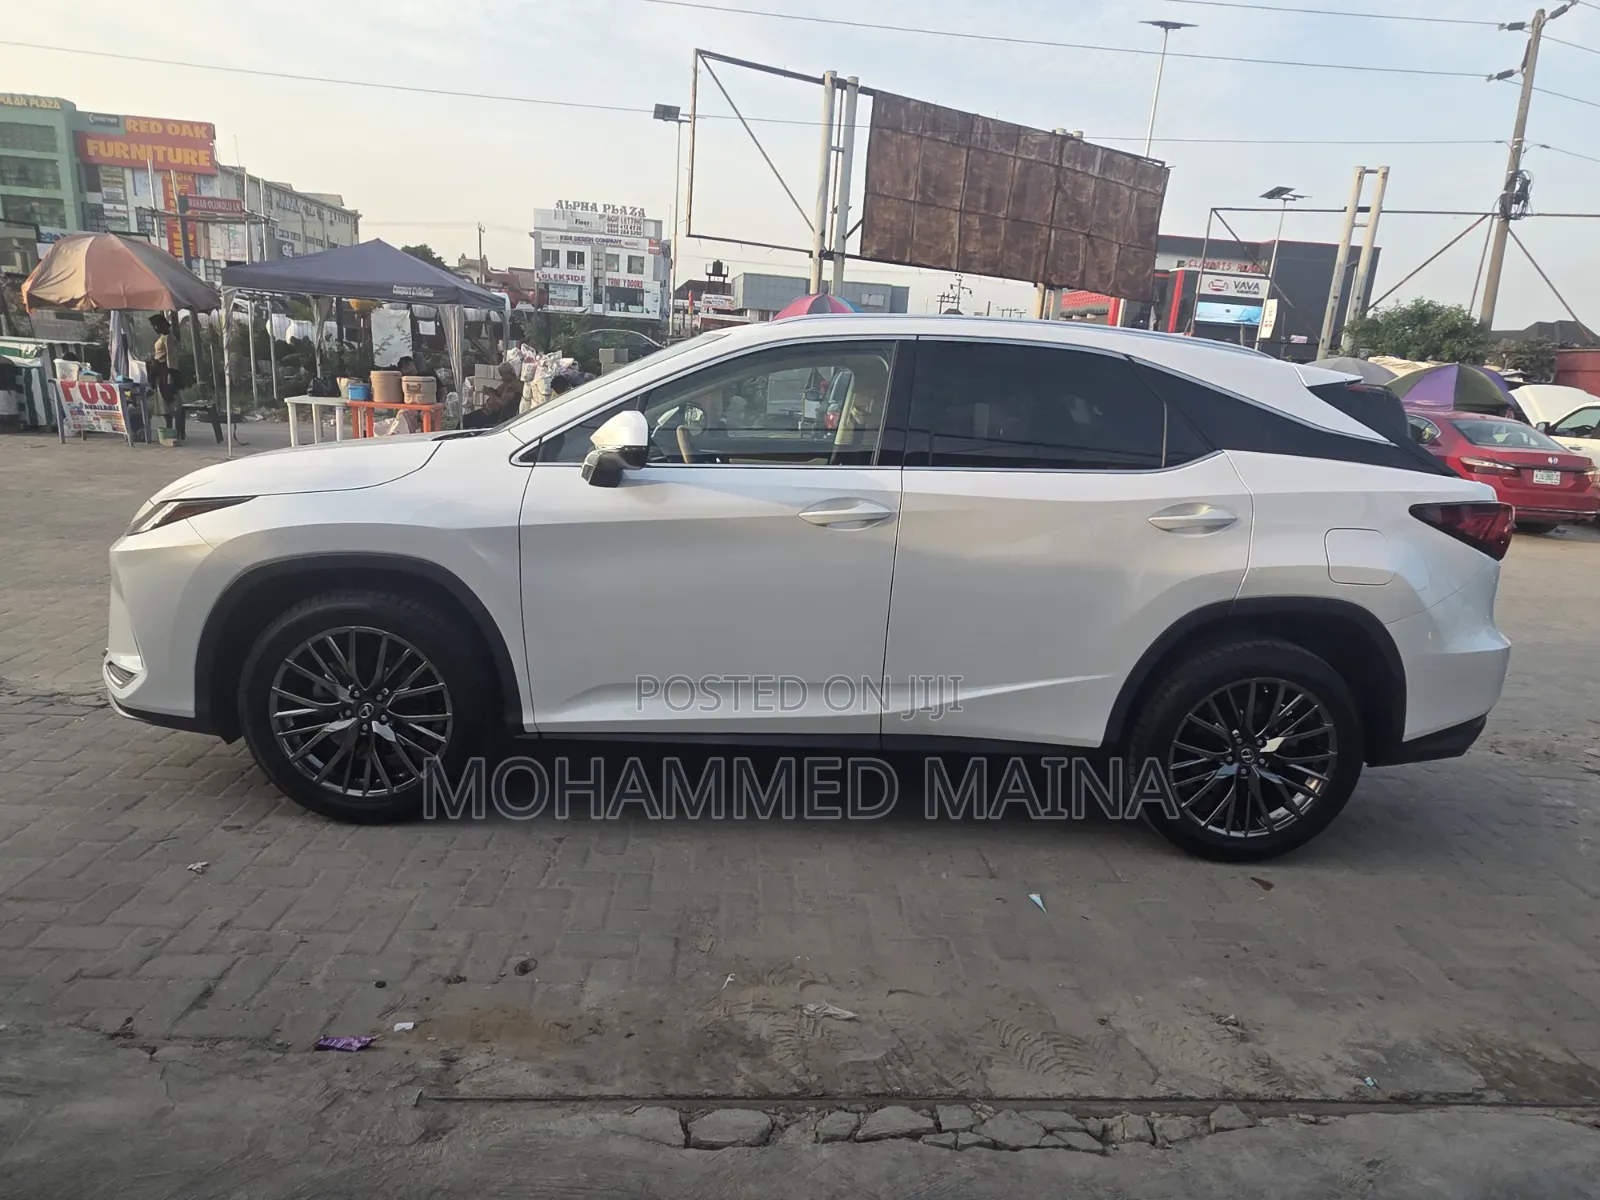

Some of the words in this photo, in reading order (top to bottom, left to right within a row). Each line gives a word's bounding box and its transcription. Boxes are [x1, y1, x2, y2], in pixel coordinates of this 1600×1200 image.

[30, 98, 61, 109] PLAZA
[126, 119, 163, 134] RED
[166, 123, 208, 138] OAK
[87, 139, 210, 166] FURNITURE
[556, 200, 598, 212] ALPHA
[603, 204, 646, 217] PLAZA
[1234, 280, 1260, 291] VAVA
